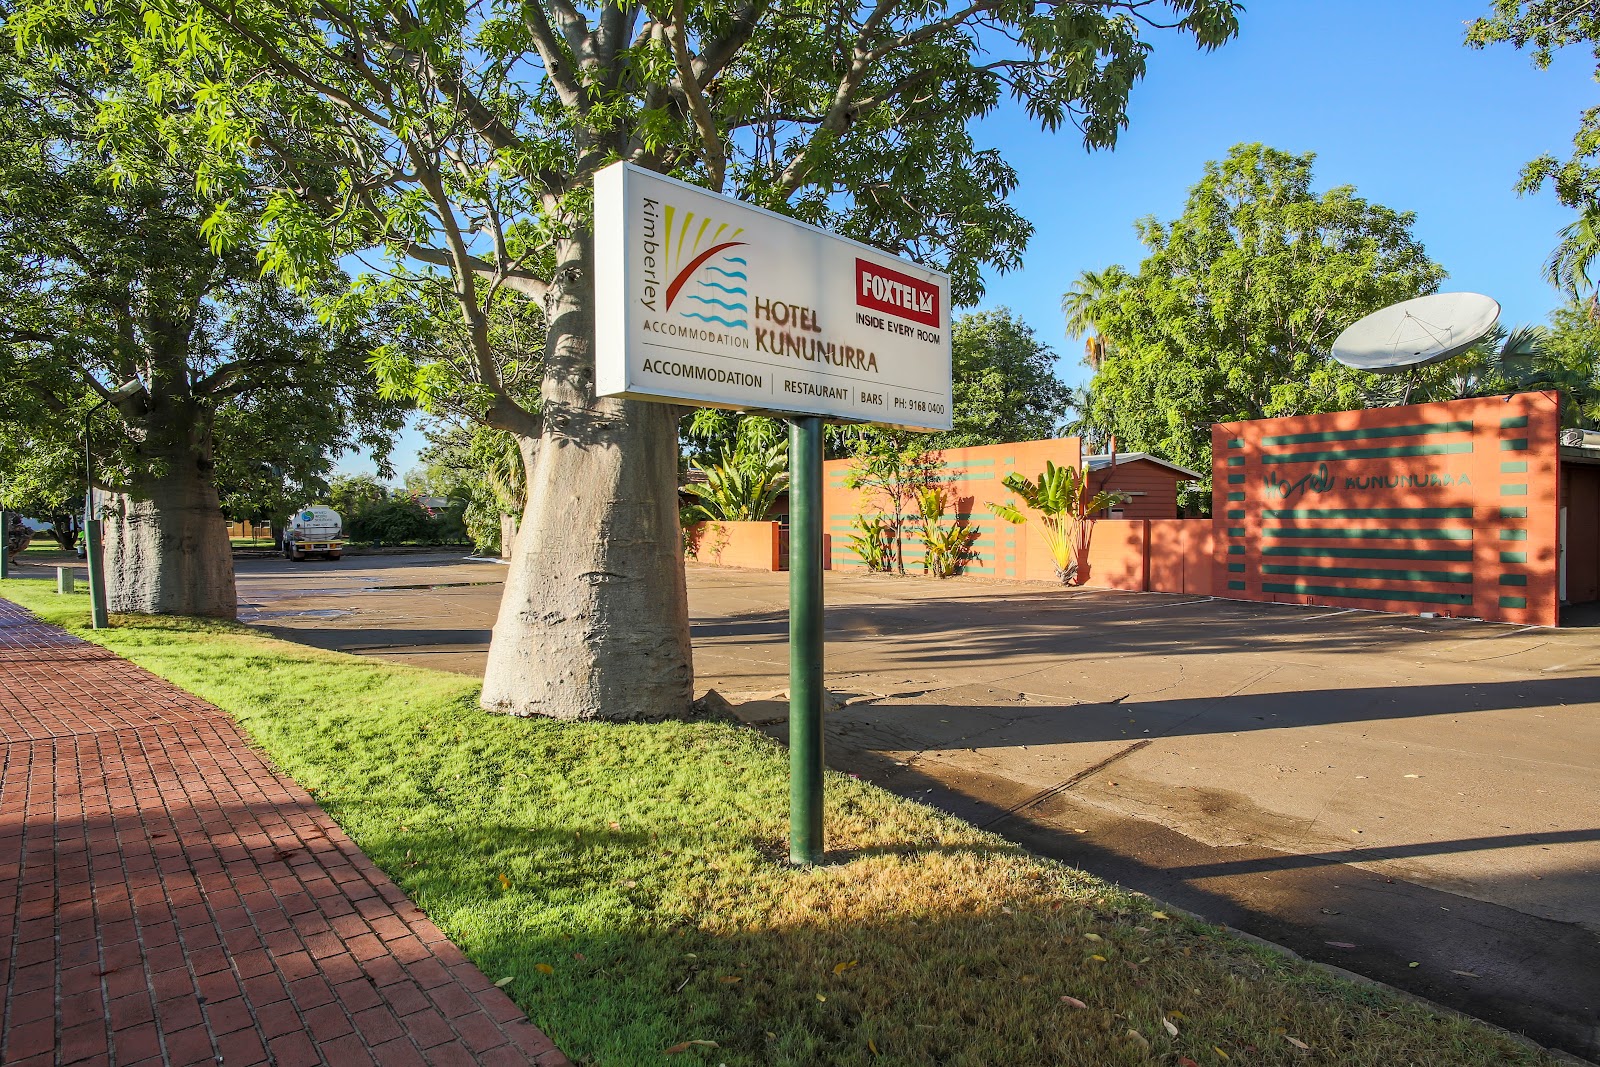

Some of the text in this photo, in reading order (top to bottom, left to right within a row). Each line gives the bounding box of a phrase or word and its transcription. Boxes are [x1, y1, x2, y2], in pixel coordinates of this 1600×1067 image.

[641, 197, 660, 312] kimberley
[862, 270, 920, 312] FOXTEL
[755, 296, 821, 333] HOTEL
[856, 312, 941, 345] INSIDE EVERY ROOM
[643, 319, 749, 349] ACCOMMODATION
[755, 327, 879, 373] KUNUNURRA
[642, 358, 762, 388] ACCOMMODATION
[784, 379, 848, 400] RESTAURANT
[860, 391, 883, 406] BARS
[894, 397, 945, 415] PH: 9168 0400
[1345, 473, 1472, 489] KUNUNURRA
